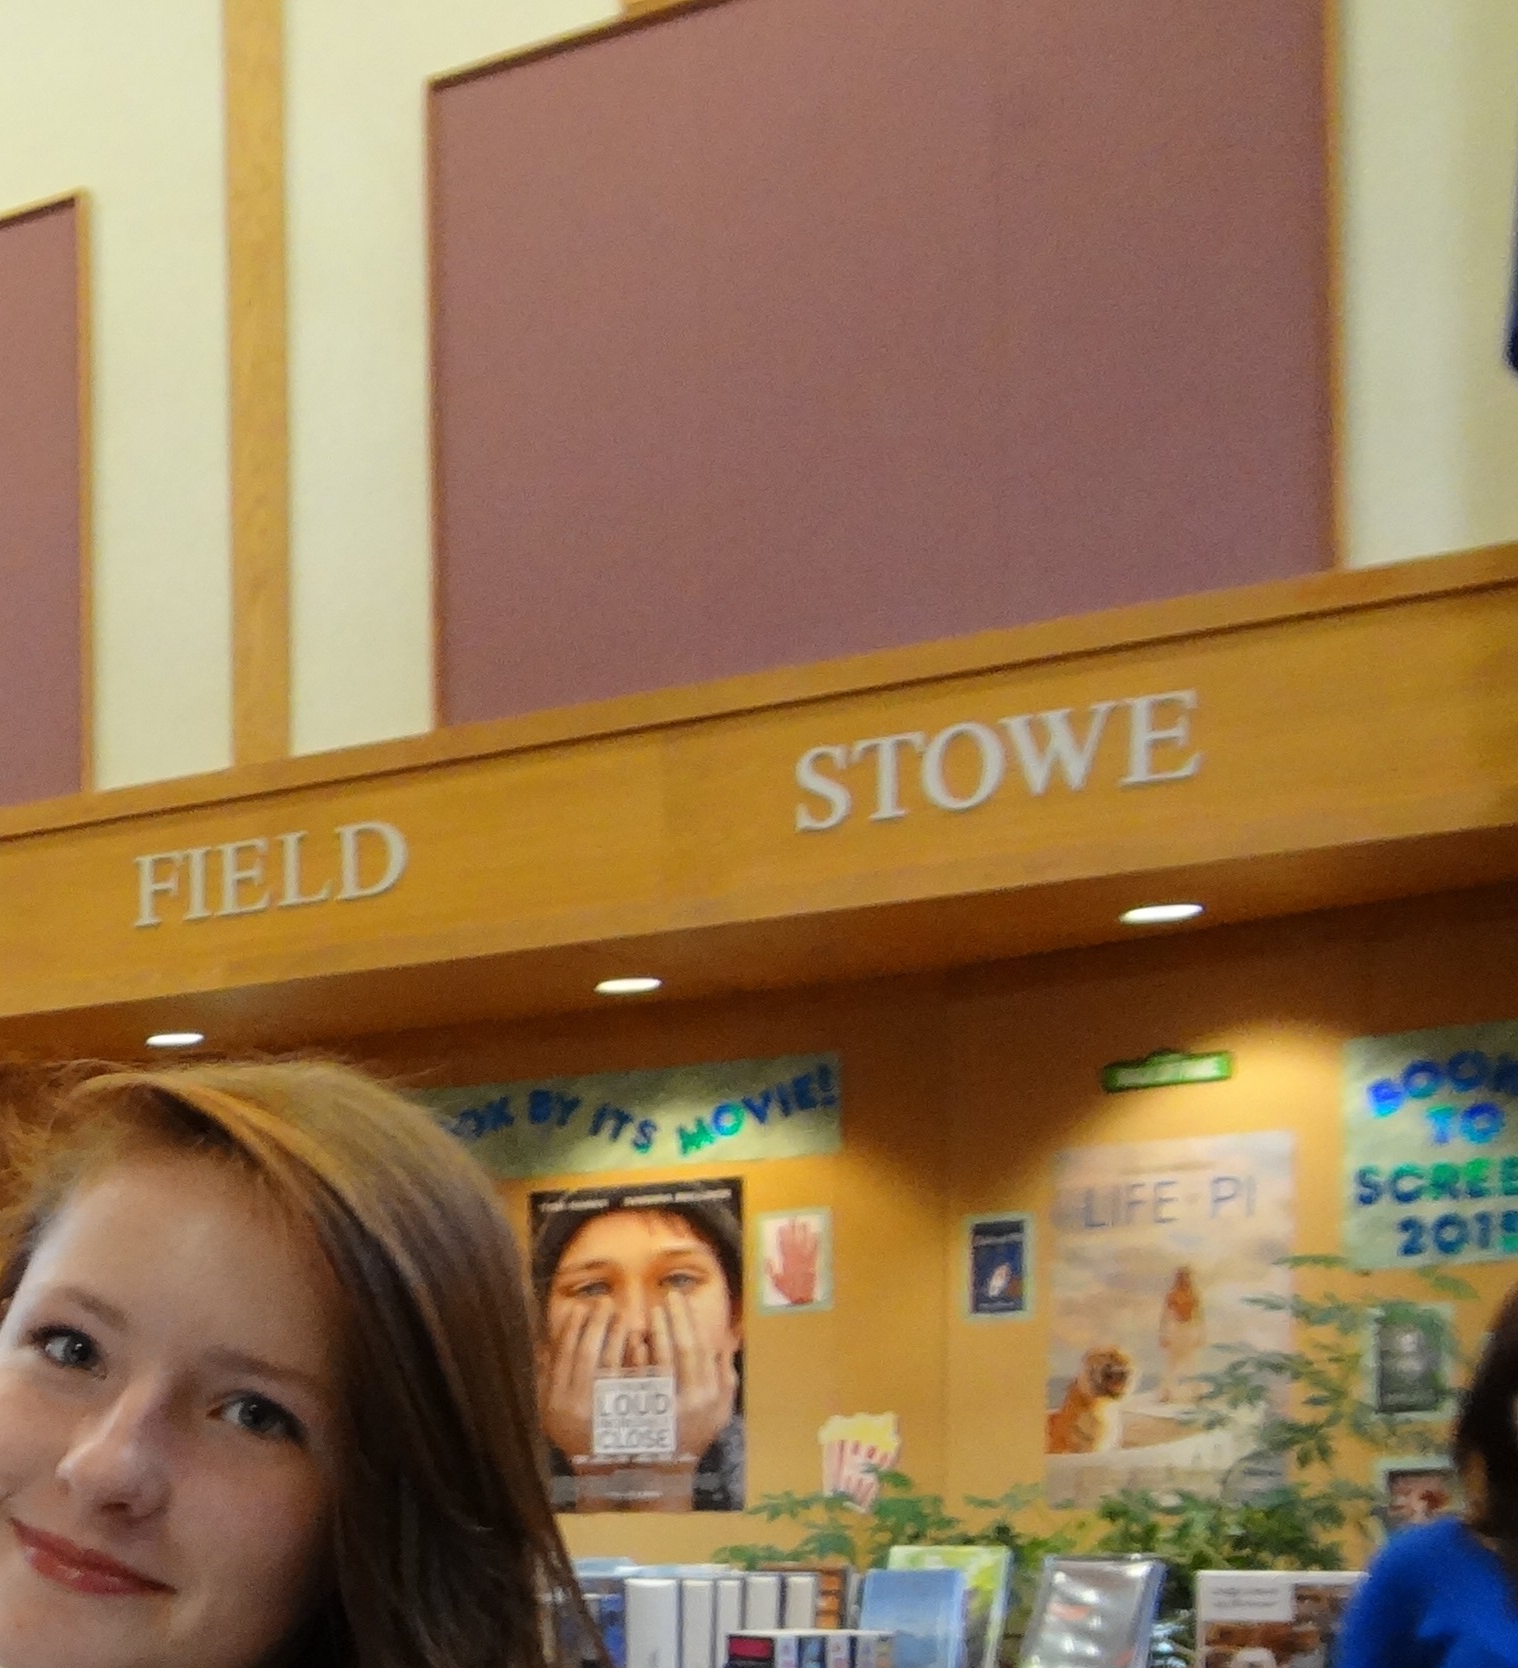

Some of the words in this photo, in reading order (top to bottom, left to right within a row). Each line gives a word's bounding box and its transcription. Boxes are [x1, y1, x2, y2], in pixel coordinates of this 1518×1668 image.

[794, 689, 1202, 832] STOWE
[132, 820, 409, 928] FIELD
[528, 1088, 582, 1127] BY
[588, 1101, 658, 1154] ITS
[675, 1064, 839, 1155] MOVIE!
[1426, 1102, 1505, 1144] TO
[1083, 1180, 1180, 1229] LIFE
[1210, 1175, 1257, 1219] PI
